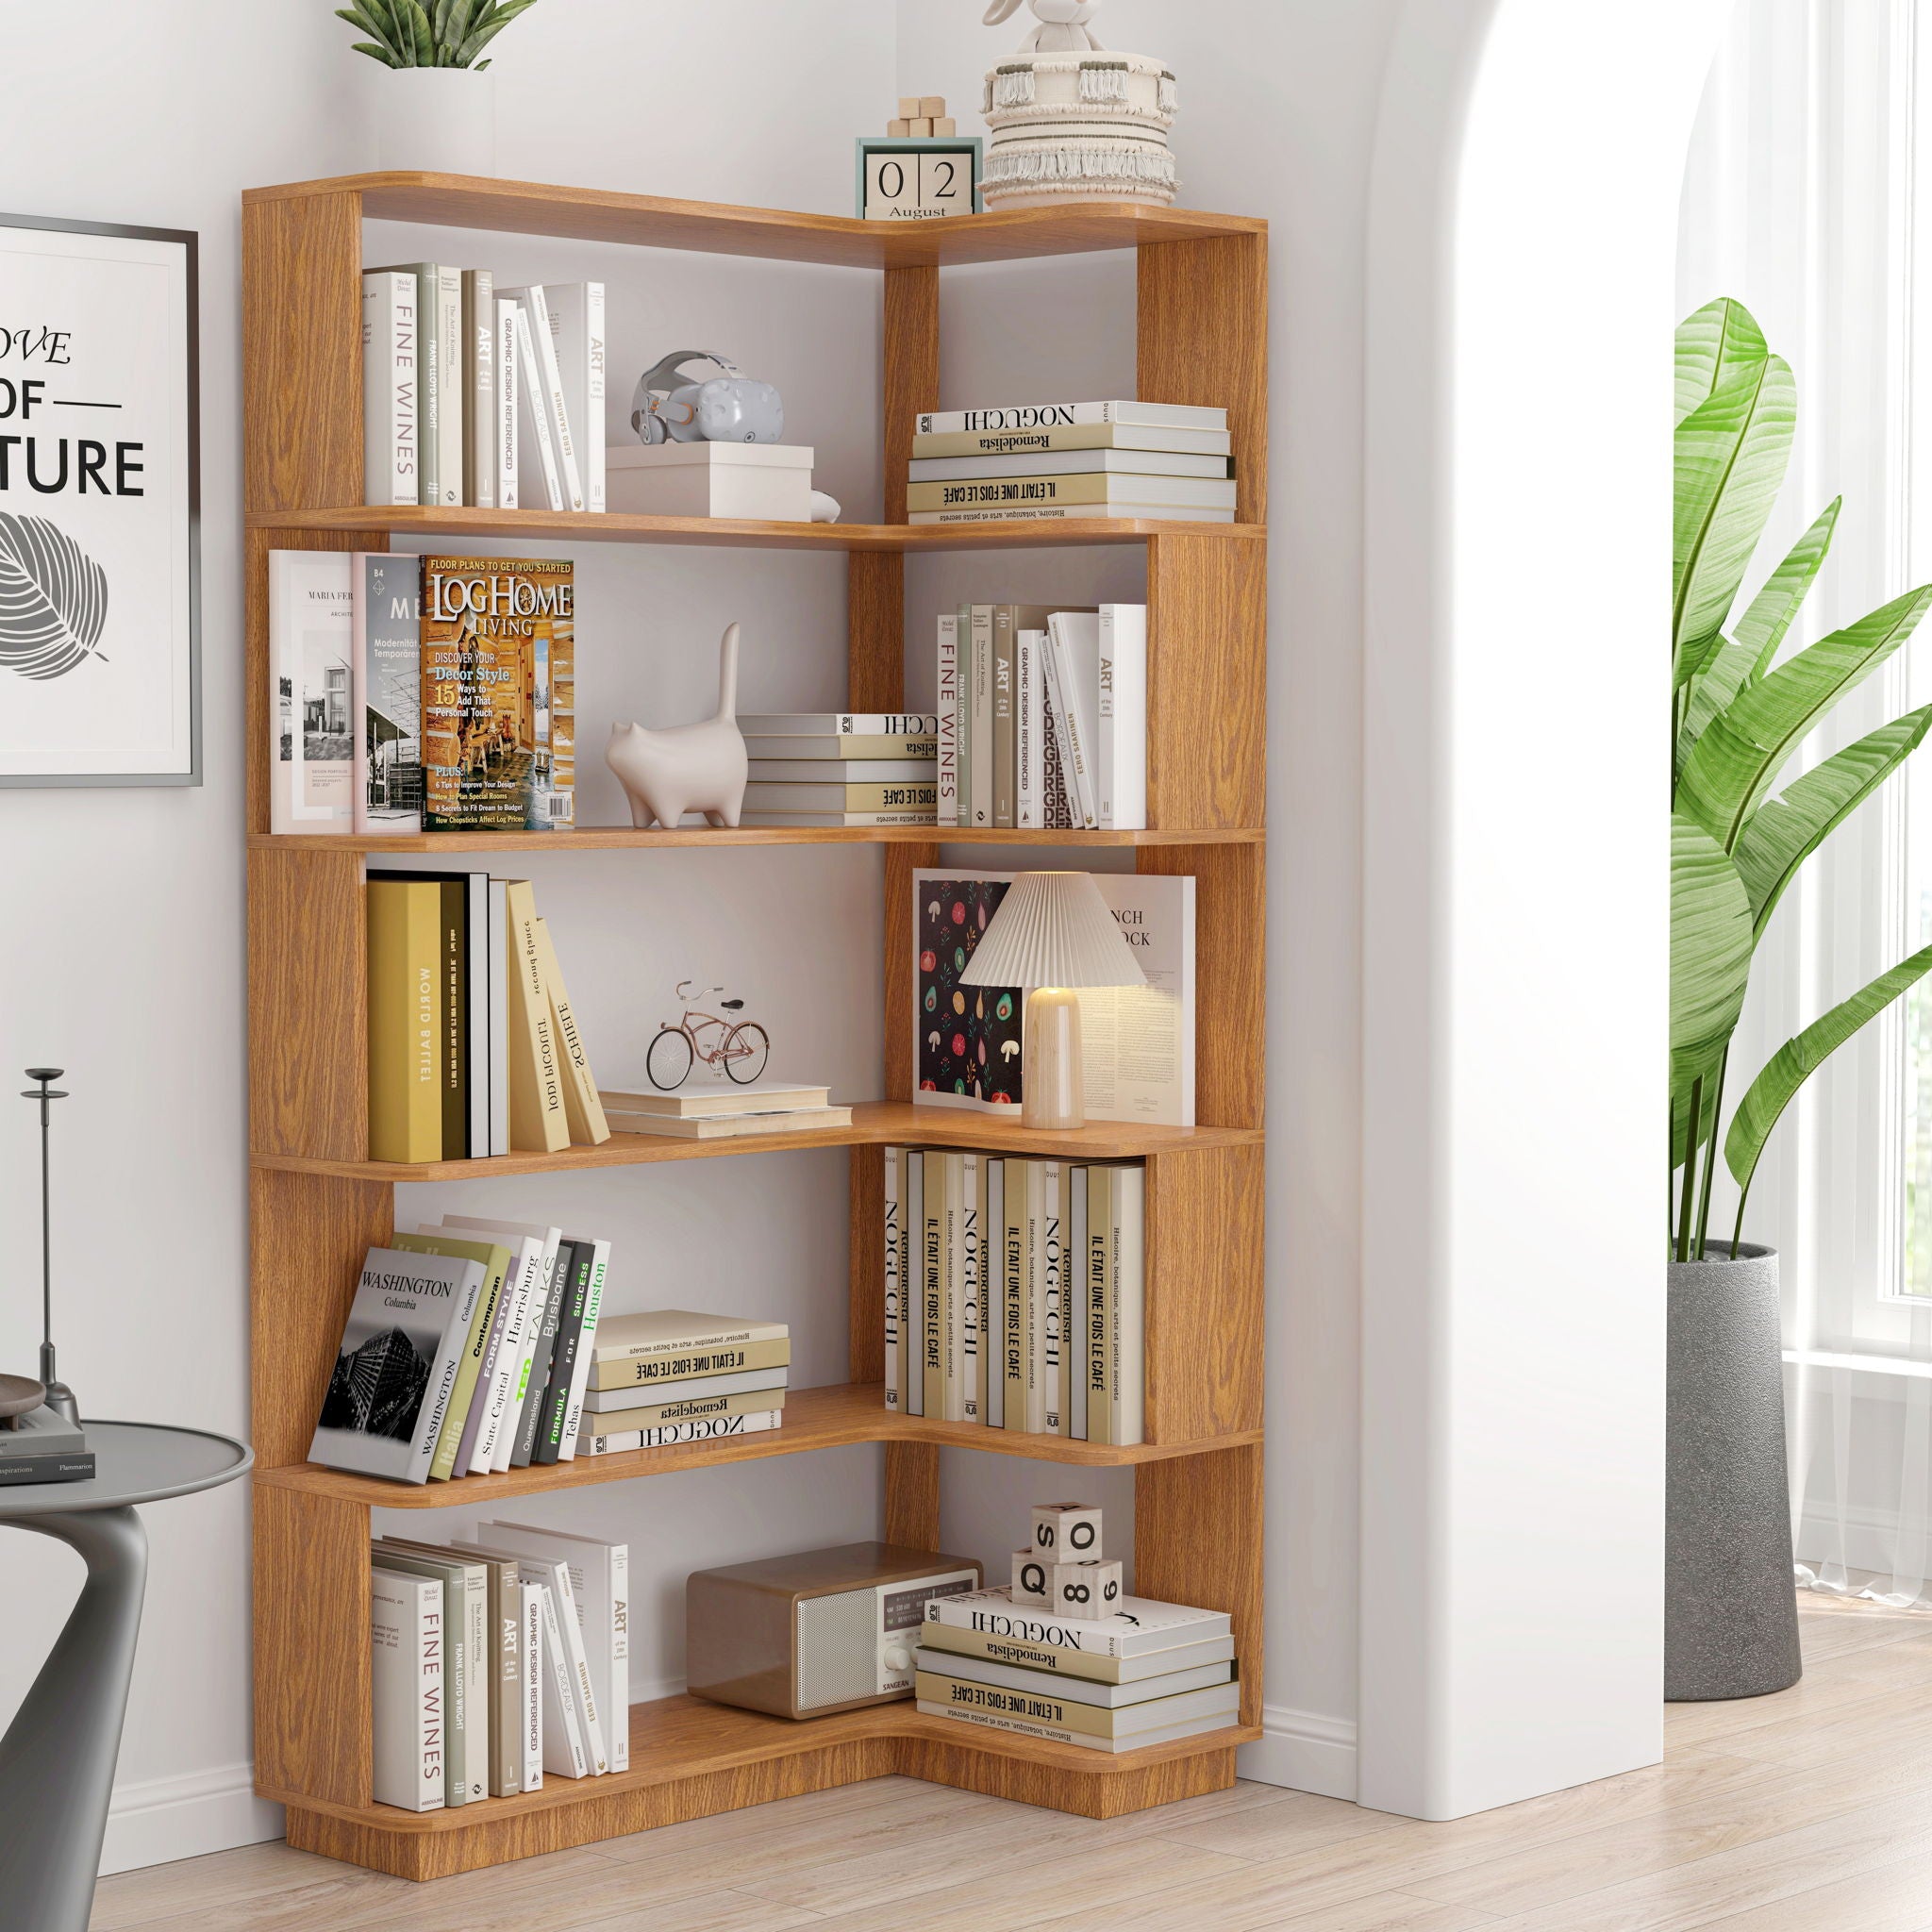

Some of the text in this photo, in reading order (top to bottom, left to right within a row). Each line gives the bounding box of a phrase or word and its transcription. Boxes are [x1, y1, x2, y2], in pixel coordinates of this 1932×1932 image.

[890, 207, 946, 220] August
[396, 306, 412, 368] FINE
[478, 326, 491, 364] ART
[591, 337, 604, 374] ART
[396, 382, 413, 475] WINES
[964, 406, 1076, 431] NOGUCHI
[979, 435, 1050, 451] Remodelista
[943, 482, 1056, 506] IL ÉTAIT UNE FOIS LE CAFÉ
[374, 569, 384, 577] B4
[430, 559, 571, 574] FLOOR PLANS TO GET YOU STARTED
[308, 591, 335, 600] MARIA
[374, 639, 418, 648] Modernität
[474, 618, 533, 636] LIVING
[435, 652, 495, 664] DISCOVER YOUR
[941, 644, 955, 700] FINE
[435, 667, 510, 684] Decor Style
[457, 684, 487, 693] Ways to
[997, 658, 1009, 692] ART
[1100, 658, 1112, 692] ART
[435, 684, 455, 705] 15
[457, 696, 491, 706] Add That
[435, 708, 493, 717] Personal Touch
[941, 713, 955, 798] WINES
[1068, 713, 1084, 774] EERO SAARINEN
[435, 767, 464, 777] PLUS:
[441, 781, 453, 790] Tips
[460, 781, 483, 790] Improve
[497, 781, 516, 790] Design
[504, 804, 524, 812] Budget
[362, 1271, 453, 1298] WASHINGTON
[583, 1263, 606, 1330] Houston
[927, 1218, 941, 1369] IL ÉTAIT UNE FOIS LE CAFÉ
[384, 1296, 417, 1310] Columbia
[473, 1275, 501, 1357] Contemporan
[483, 1279, 514, 1378] FORM STYLE
[422, 1284, 477, 1455] WASHINGTON Columbia
[482, 1256, 539, 1455] State Capital Harrisburg
[523, 1262, 567, 1451] Queensland Brisbane
[551, 1262, 589, 1445] FORMULA FOR SUCCESS
[516, 1357, 532, 1403] TED
[1021, 1563, 1046, 1596] Q
[1063, 1584, 1091, 1604] 8
[614, 1600, 626, 1634] ART
[971, 1611, 1082, 1650] NOGUCHI
[424, 1614, 440, 1675] FINE
[504, 1618, 517, 1654] ART
[987, 1643, 1057, 1668] Remodelista
[578, 1661, 595, 1723] EERO SAARINEN
[883, 1679, 908, 1690] SANGEAN
[456, 1699, 464, 1730] WRIGHT
[951, 1684, 1062, 1722] IL ÉTAIT UNE FOIS LE CAFÉ
[424, 1687, 441, 1779] WINES
